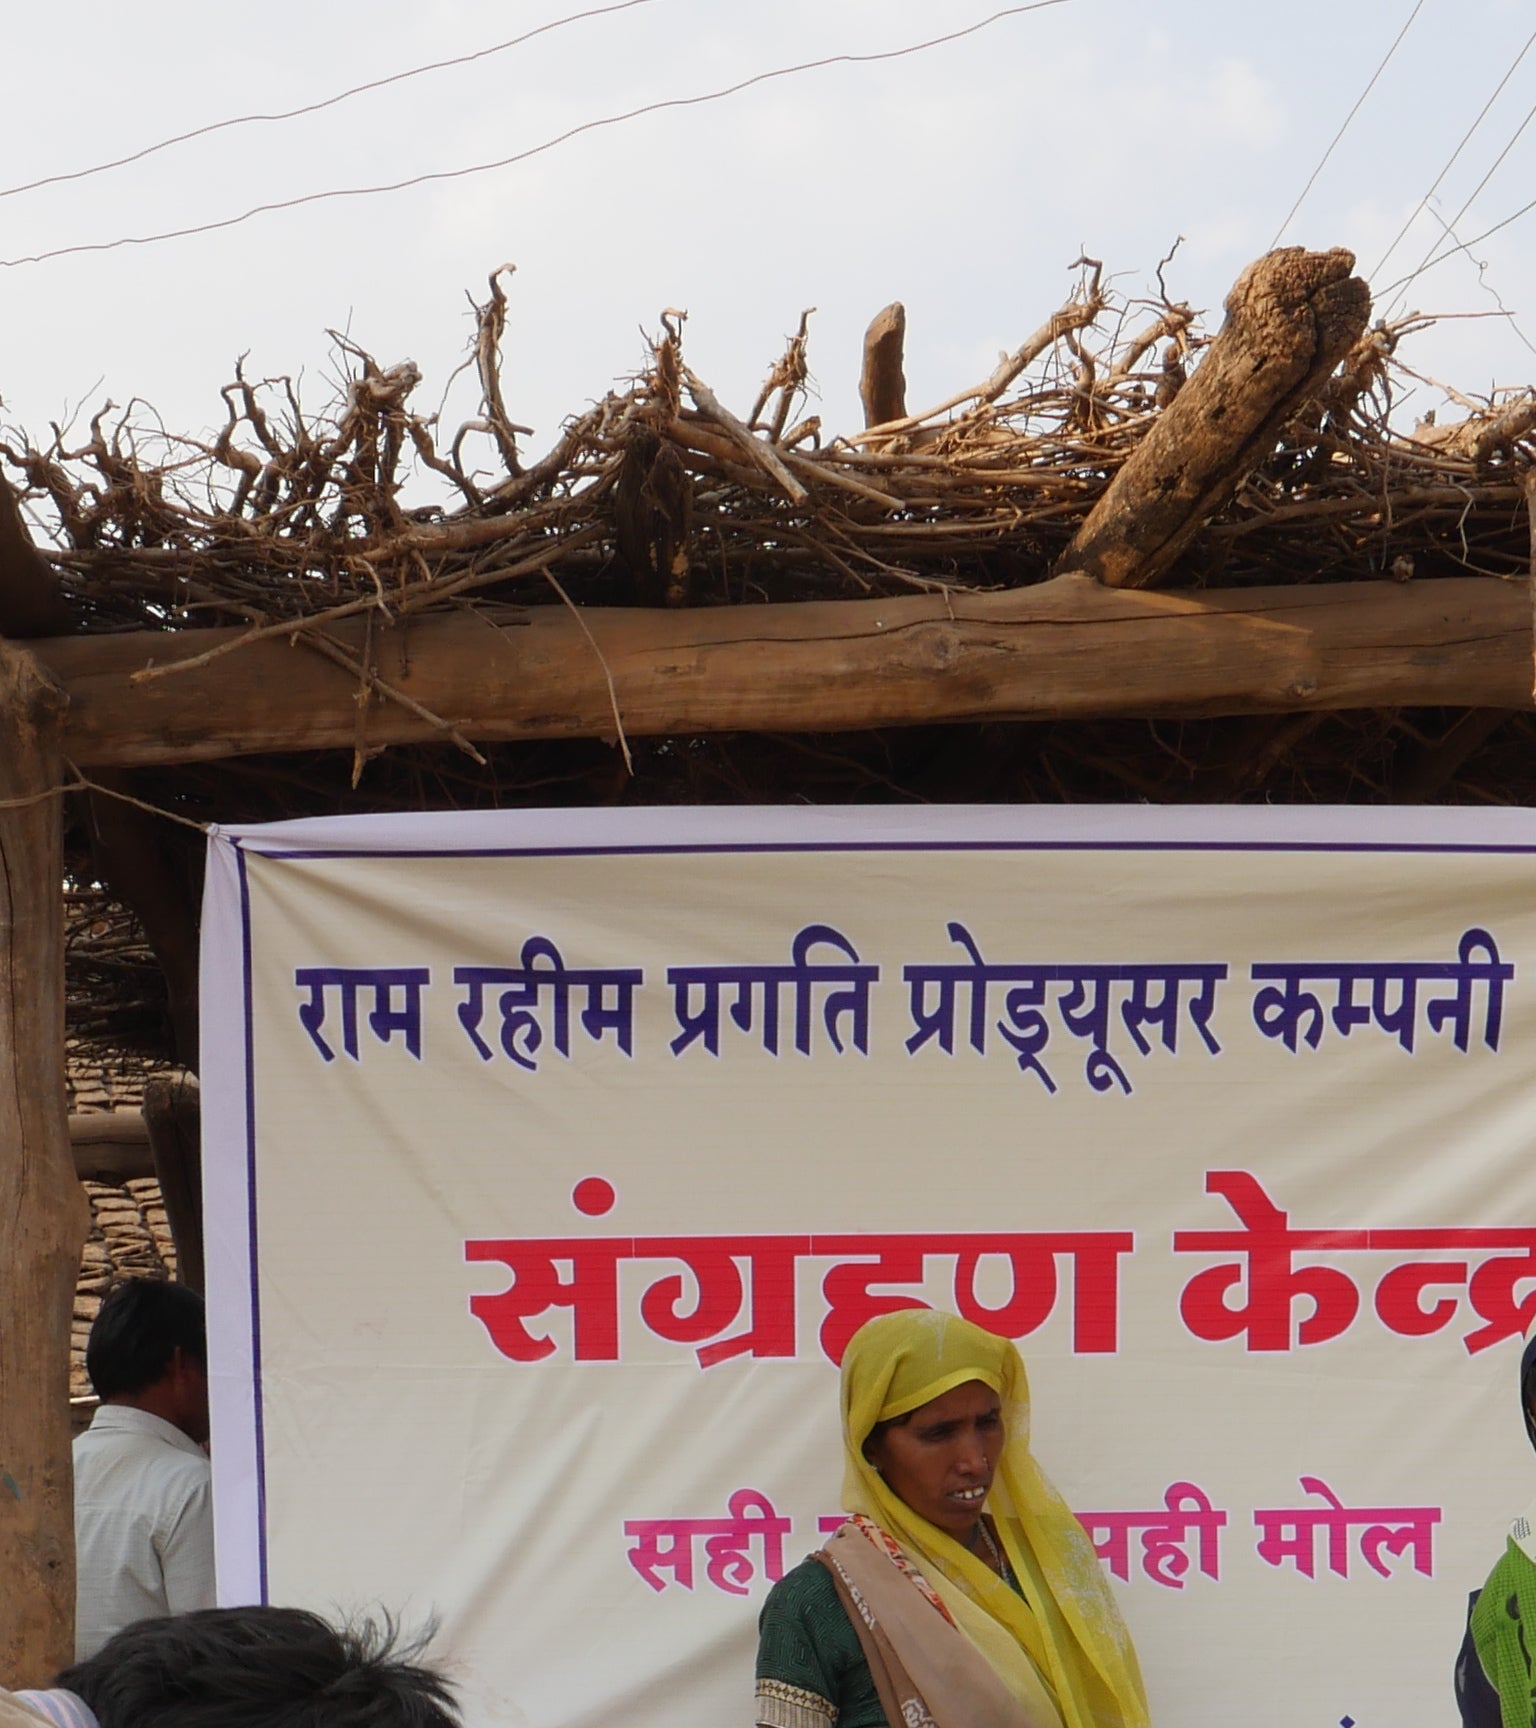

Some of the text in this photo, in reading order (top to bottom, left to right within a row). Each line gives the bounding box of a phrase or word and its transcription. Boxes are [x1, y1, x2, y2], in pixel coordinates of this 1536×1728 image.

[296, 968, 429, 1062] राम
[454, 937, 643, 1070] रहीम
[667, 926, 879, 1056] प्रगति
[904, 923, 1228, 1094] प्रोड्यूसर
[1252, 929, 1514, 1053] कम्पनी
[624, 1488, 792, 1596] सही
[1253, 1476, 1442, 1580] मोल
